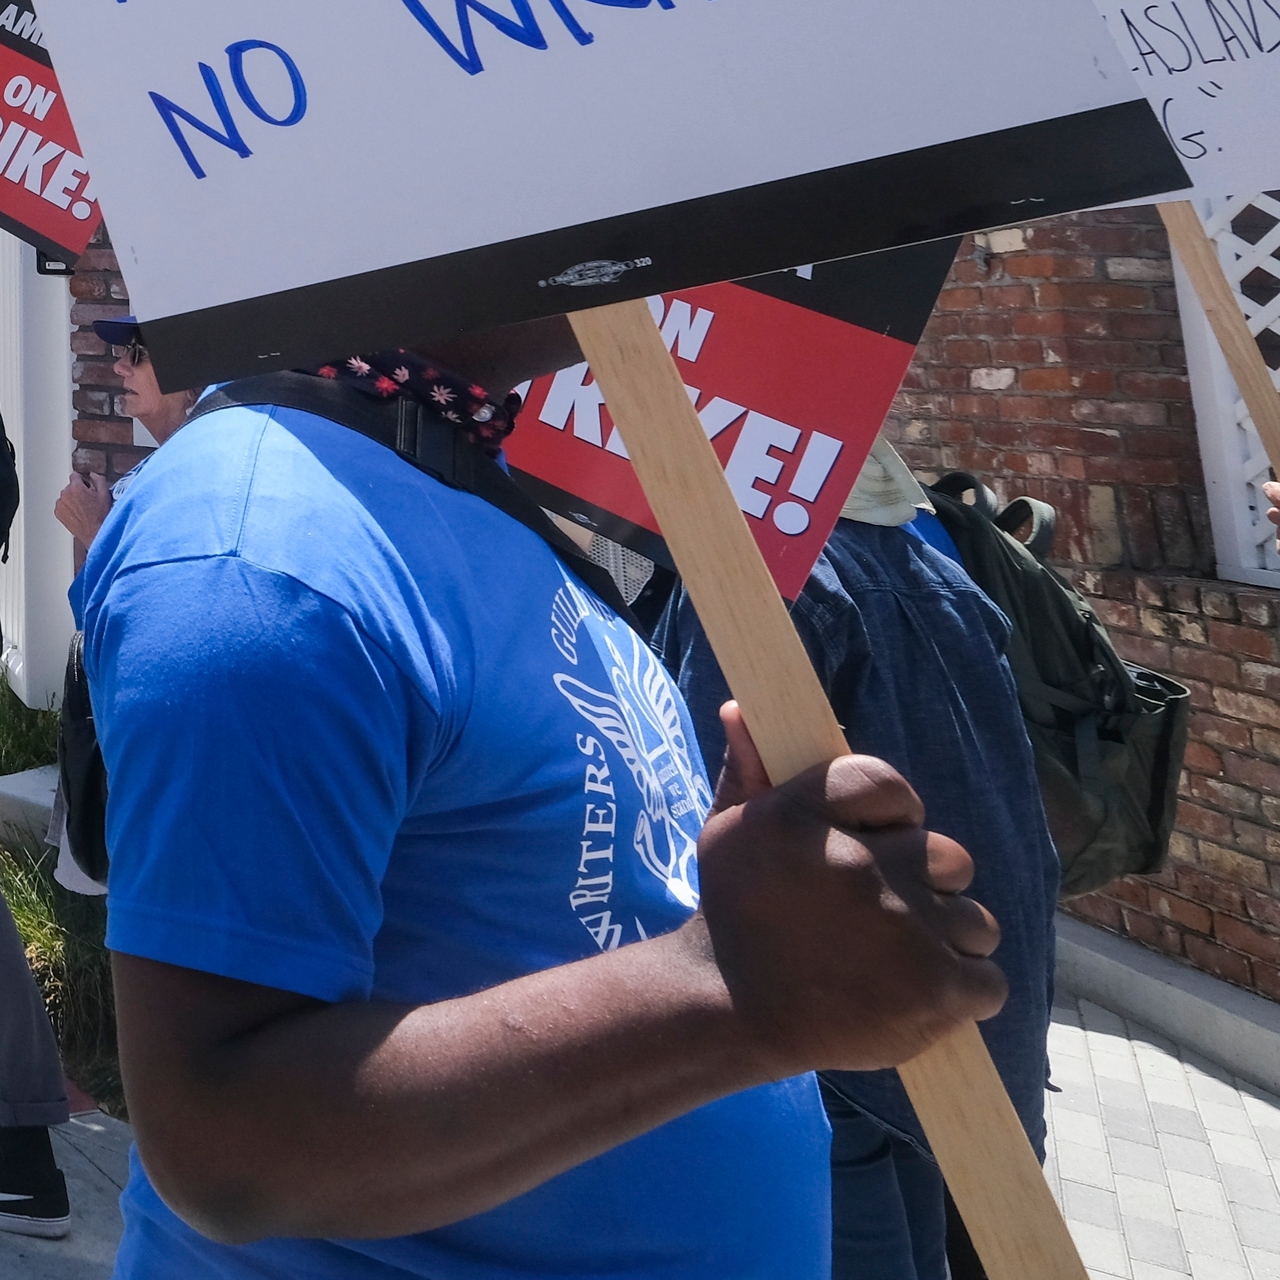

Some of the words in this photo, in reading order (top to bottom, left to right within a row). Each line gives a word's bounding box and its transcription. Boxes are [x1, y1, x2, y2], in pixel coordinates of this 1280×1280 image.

[3, 75, 58, 122] ON
[148, 39, 308, 180] NO
[551, 581, 589, 666] GUILD
[570, 732, 623, 952] WRITERS
